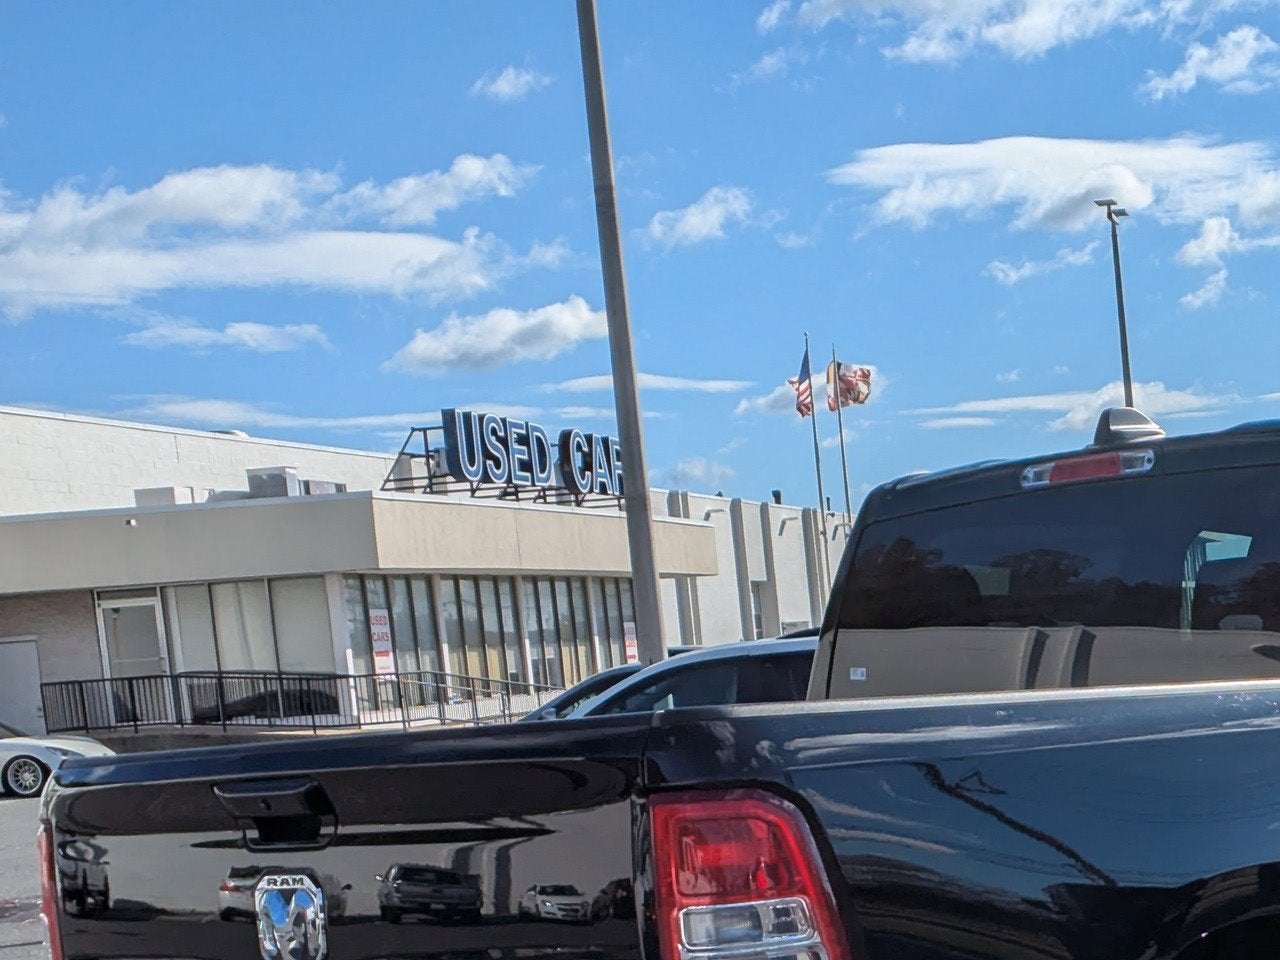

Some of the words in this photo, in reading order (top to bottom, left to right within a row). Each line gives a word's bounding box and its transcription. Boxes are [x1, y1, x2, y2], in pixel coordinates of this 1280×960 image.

[454, 408, 550, 487] USED
[370, 615, 387, 626] USED
[372, 631, 390, 642] CARS
[266, 877, 304, 887] RAM
